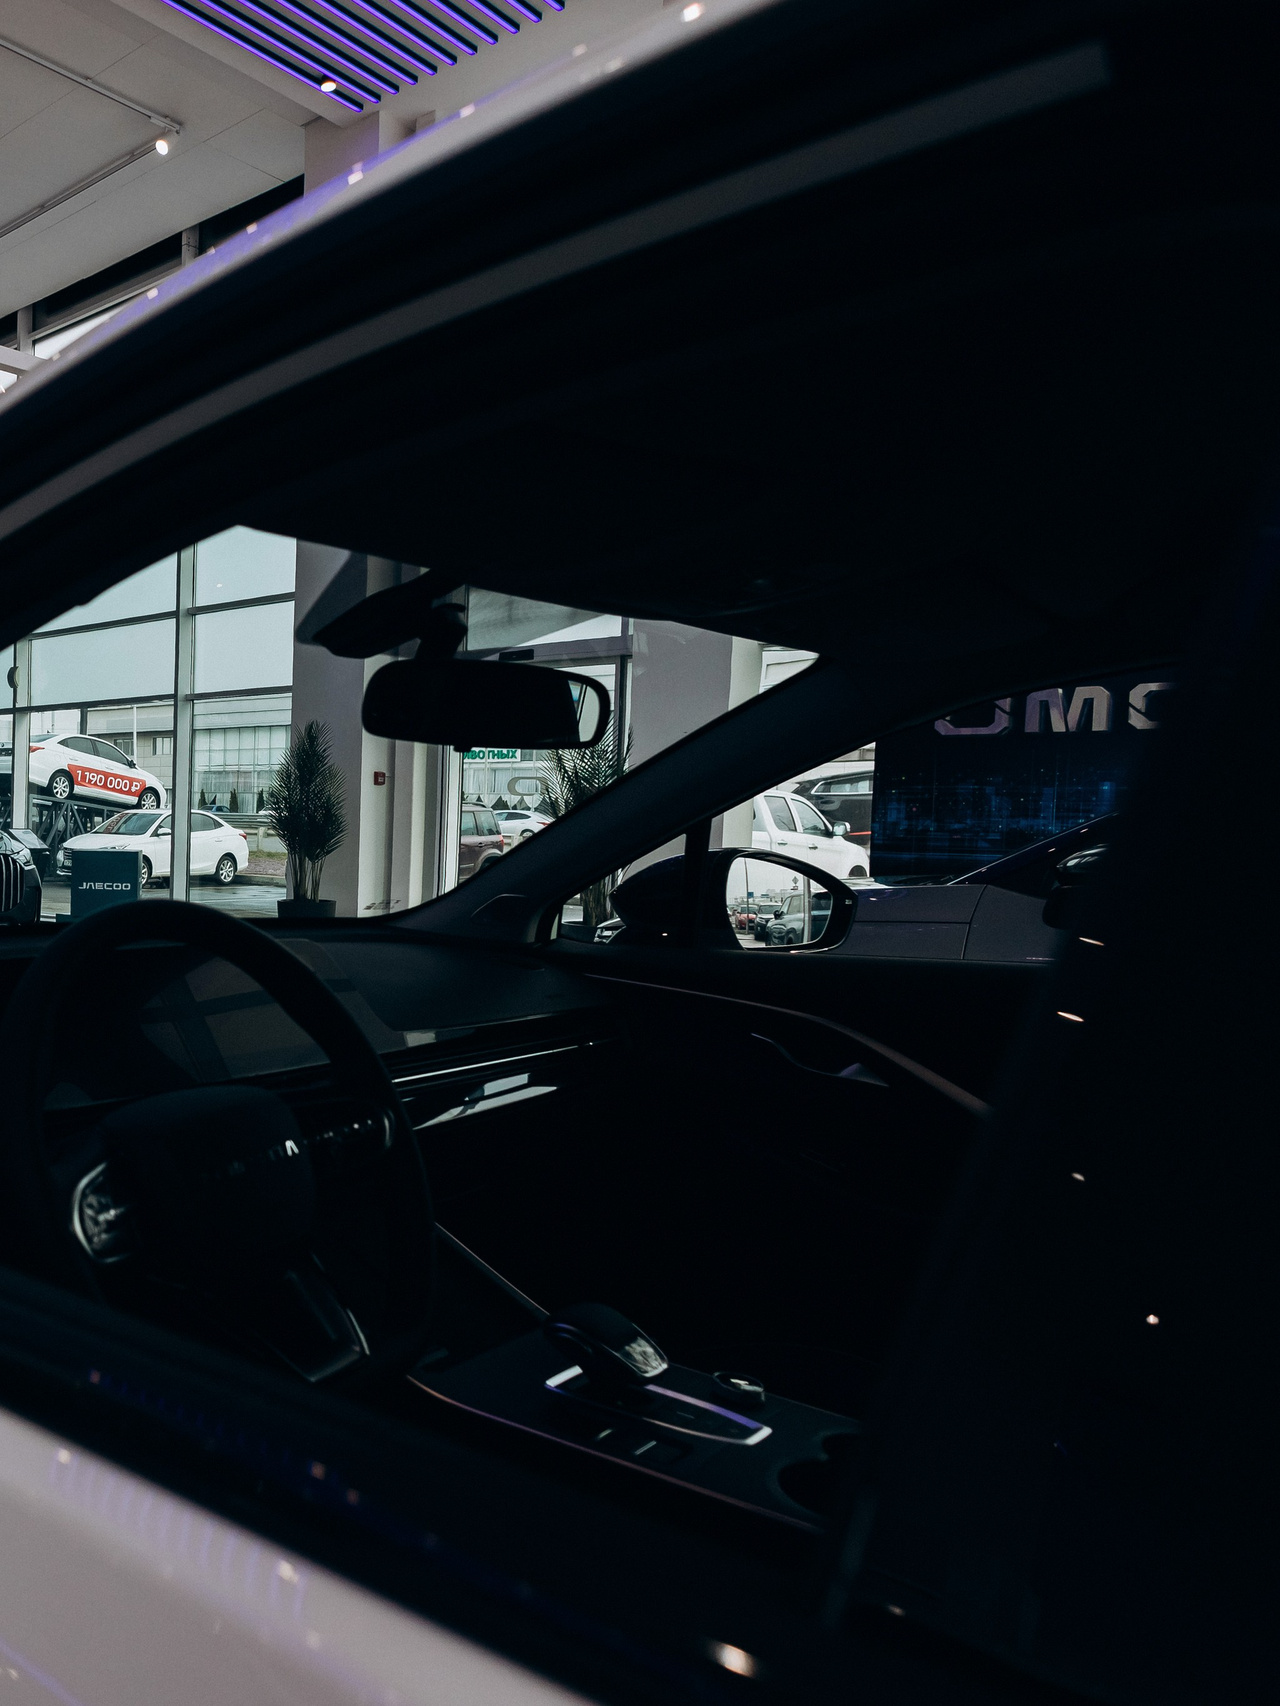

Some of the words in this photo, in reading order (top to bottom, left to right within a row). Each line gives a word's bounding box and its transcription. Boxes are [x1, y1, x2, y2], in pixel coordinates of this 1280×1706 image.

[76, 770, 82, 782] 1
[84, 771, 105, 786] 190
[106, 776, 130, 792] 000
[78, 882, 131, 890] JAECOO
